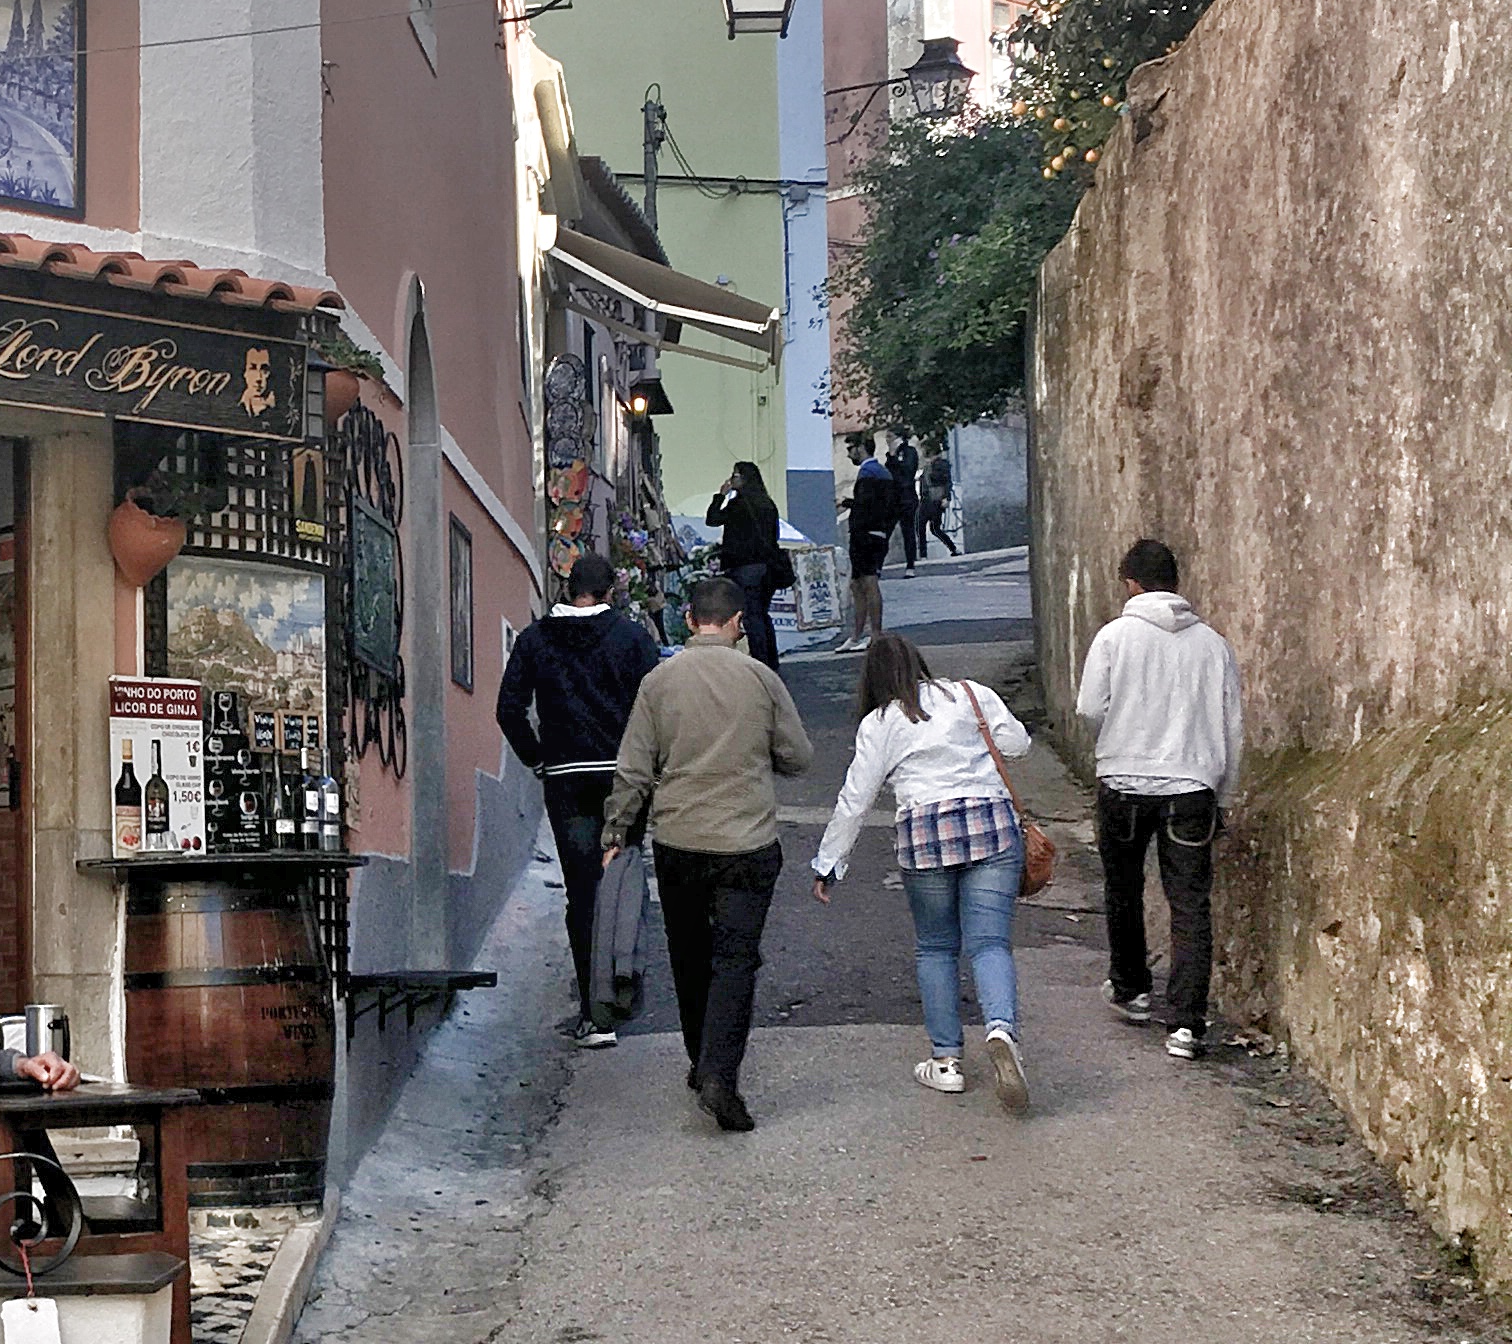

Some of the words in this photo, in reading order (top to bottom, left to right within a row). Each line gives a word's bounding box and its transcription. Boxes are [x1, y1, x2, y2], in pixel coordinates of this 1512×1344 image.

[84, 338, 232, 414] Byron
[146, 688, 161, 699] DO
[163, 689, 197, 701] PORTO
[114, 702, 147, 714] LICOR
[149, 703, 164, 715] DE
[166, 705, 198, 716] GINJA
[186, 740, 201, 753] 1€
[173, 790, 202, 804] 1,50€
